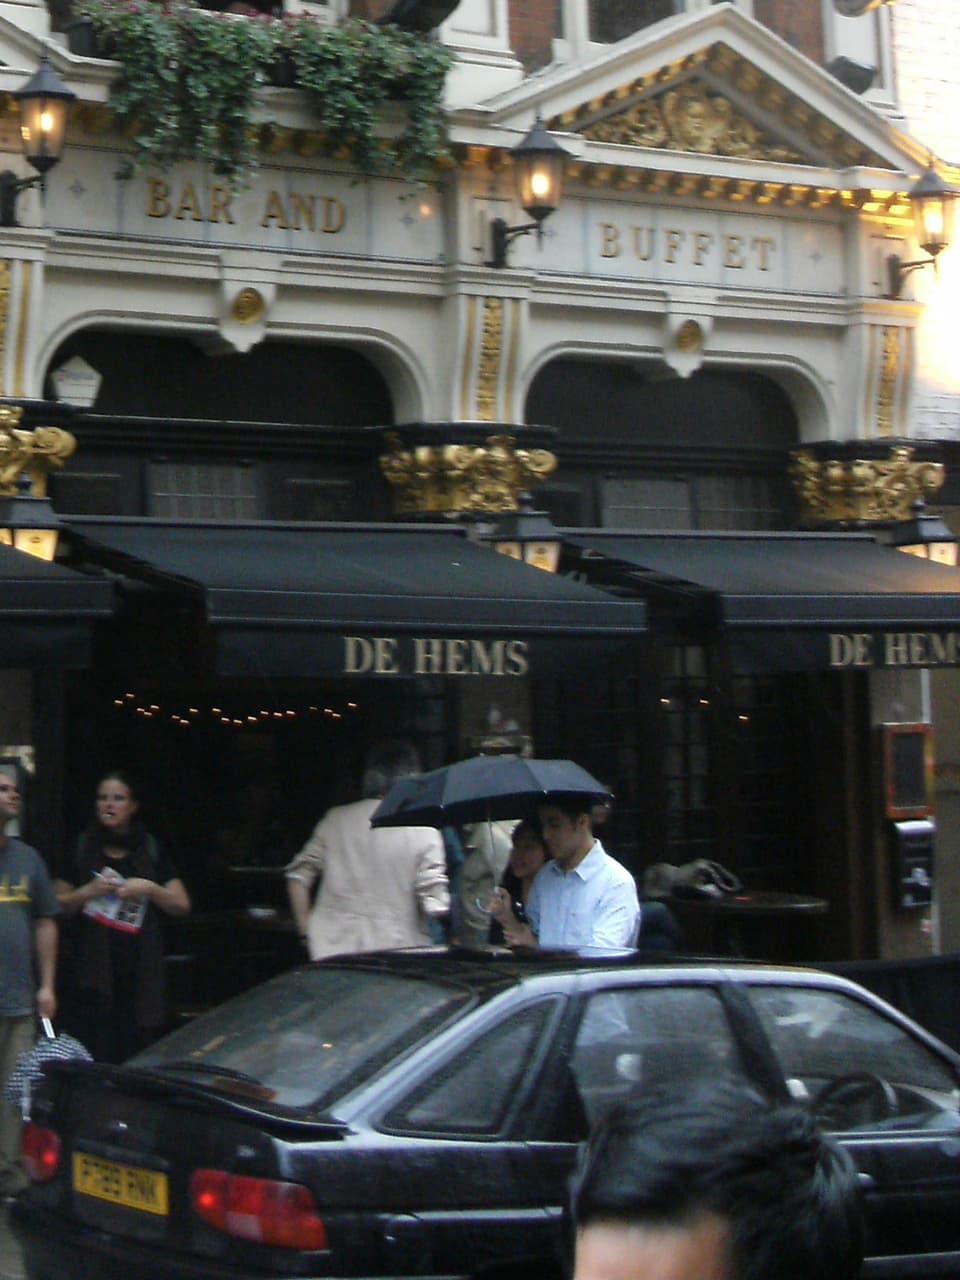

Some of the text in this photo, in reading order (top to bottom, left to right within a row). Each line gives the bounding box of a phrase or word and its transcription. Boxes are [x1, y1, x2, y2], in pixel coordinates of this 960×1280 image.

[145, 177, 346, 234] BAR AND
[599, 223, 776, 272] BUFFET
[344, 636, 529, 675] DE HEMS
[829, 632, 960, 666] DE HEM
